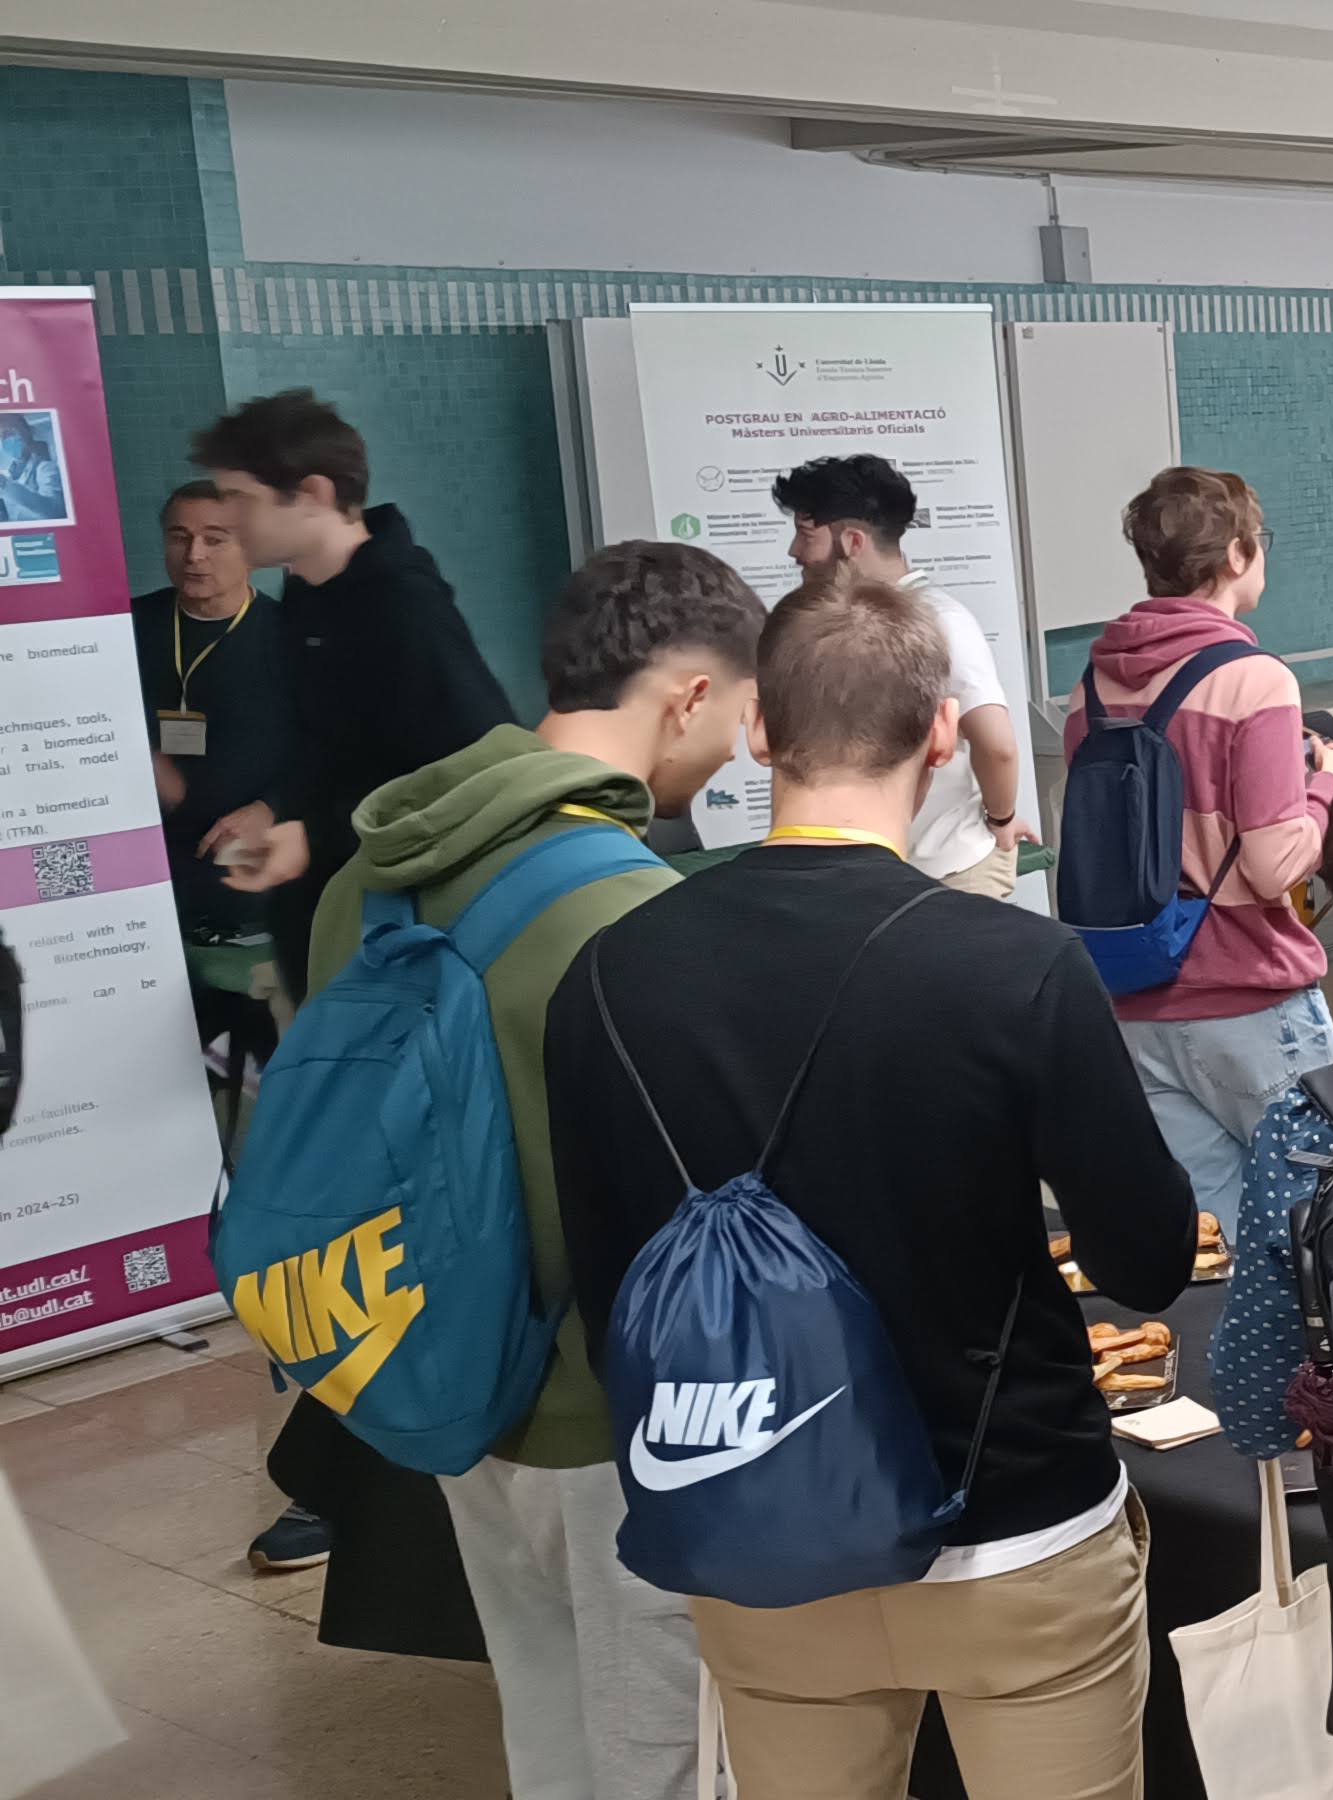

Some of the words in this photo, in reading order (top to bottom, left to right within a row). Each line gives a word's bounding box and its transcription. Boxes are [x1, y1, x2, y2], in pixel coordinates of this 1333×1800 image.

[705, 413, 780, 425] POSTGRAU
[785, 412, 803, 423] EN
[811, 406, 947, 422] AGRO-ALIMENTACIÓ
[732, 427, 785, 438] Màsters
[790, 424, 874, 437] Universitaris
[877, 423, 926, 435] Oficials
[27, 643, 98, 660] biomedical
[21, 743, 29, 753] a
[44, 731, 115, 750] biomedical
[25, 759, 65, 773] trials,
[79, 751, 119, 766] model
[18, 808, 27, 817] a
[36, 795, 109, 815] biomedical
[29, 932, 74, 948] related
[86, 924, 115, 939] with
[126, 920, 147, 932] the
[54, 940, 150, 965] Biotechnology,
[93, 986, 116, 998] can
[140, 978, 157, 990] be
[233, 1206, 406, 1364] NIKE
[0, 1290, 93, 1328] b@udl.cat
[646, 1377, 776, 1447] NIKE
